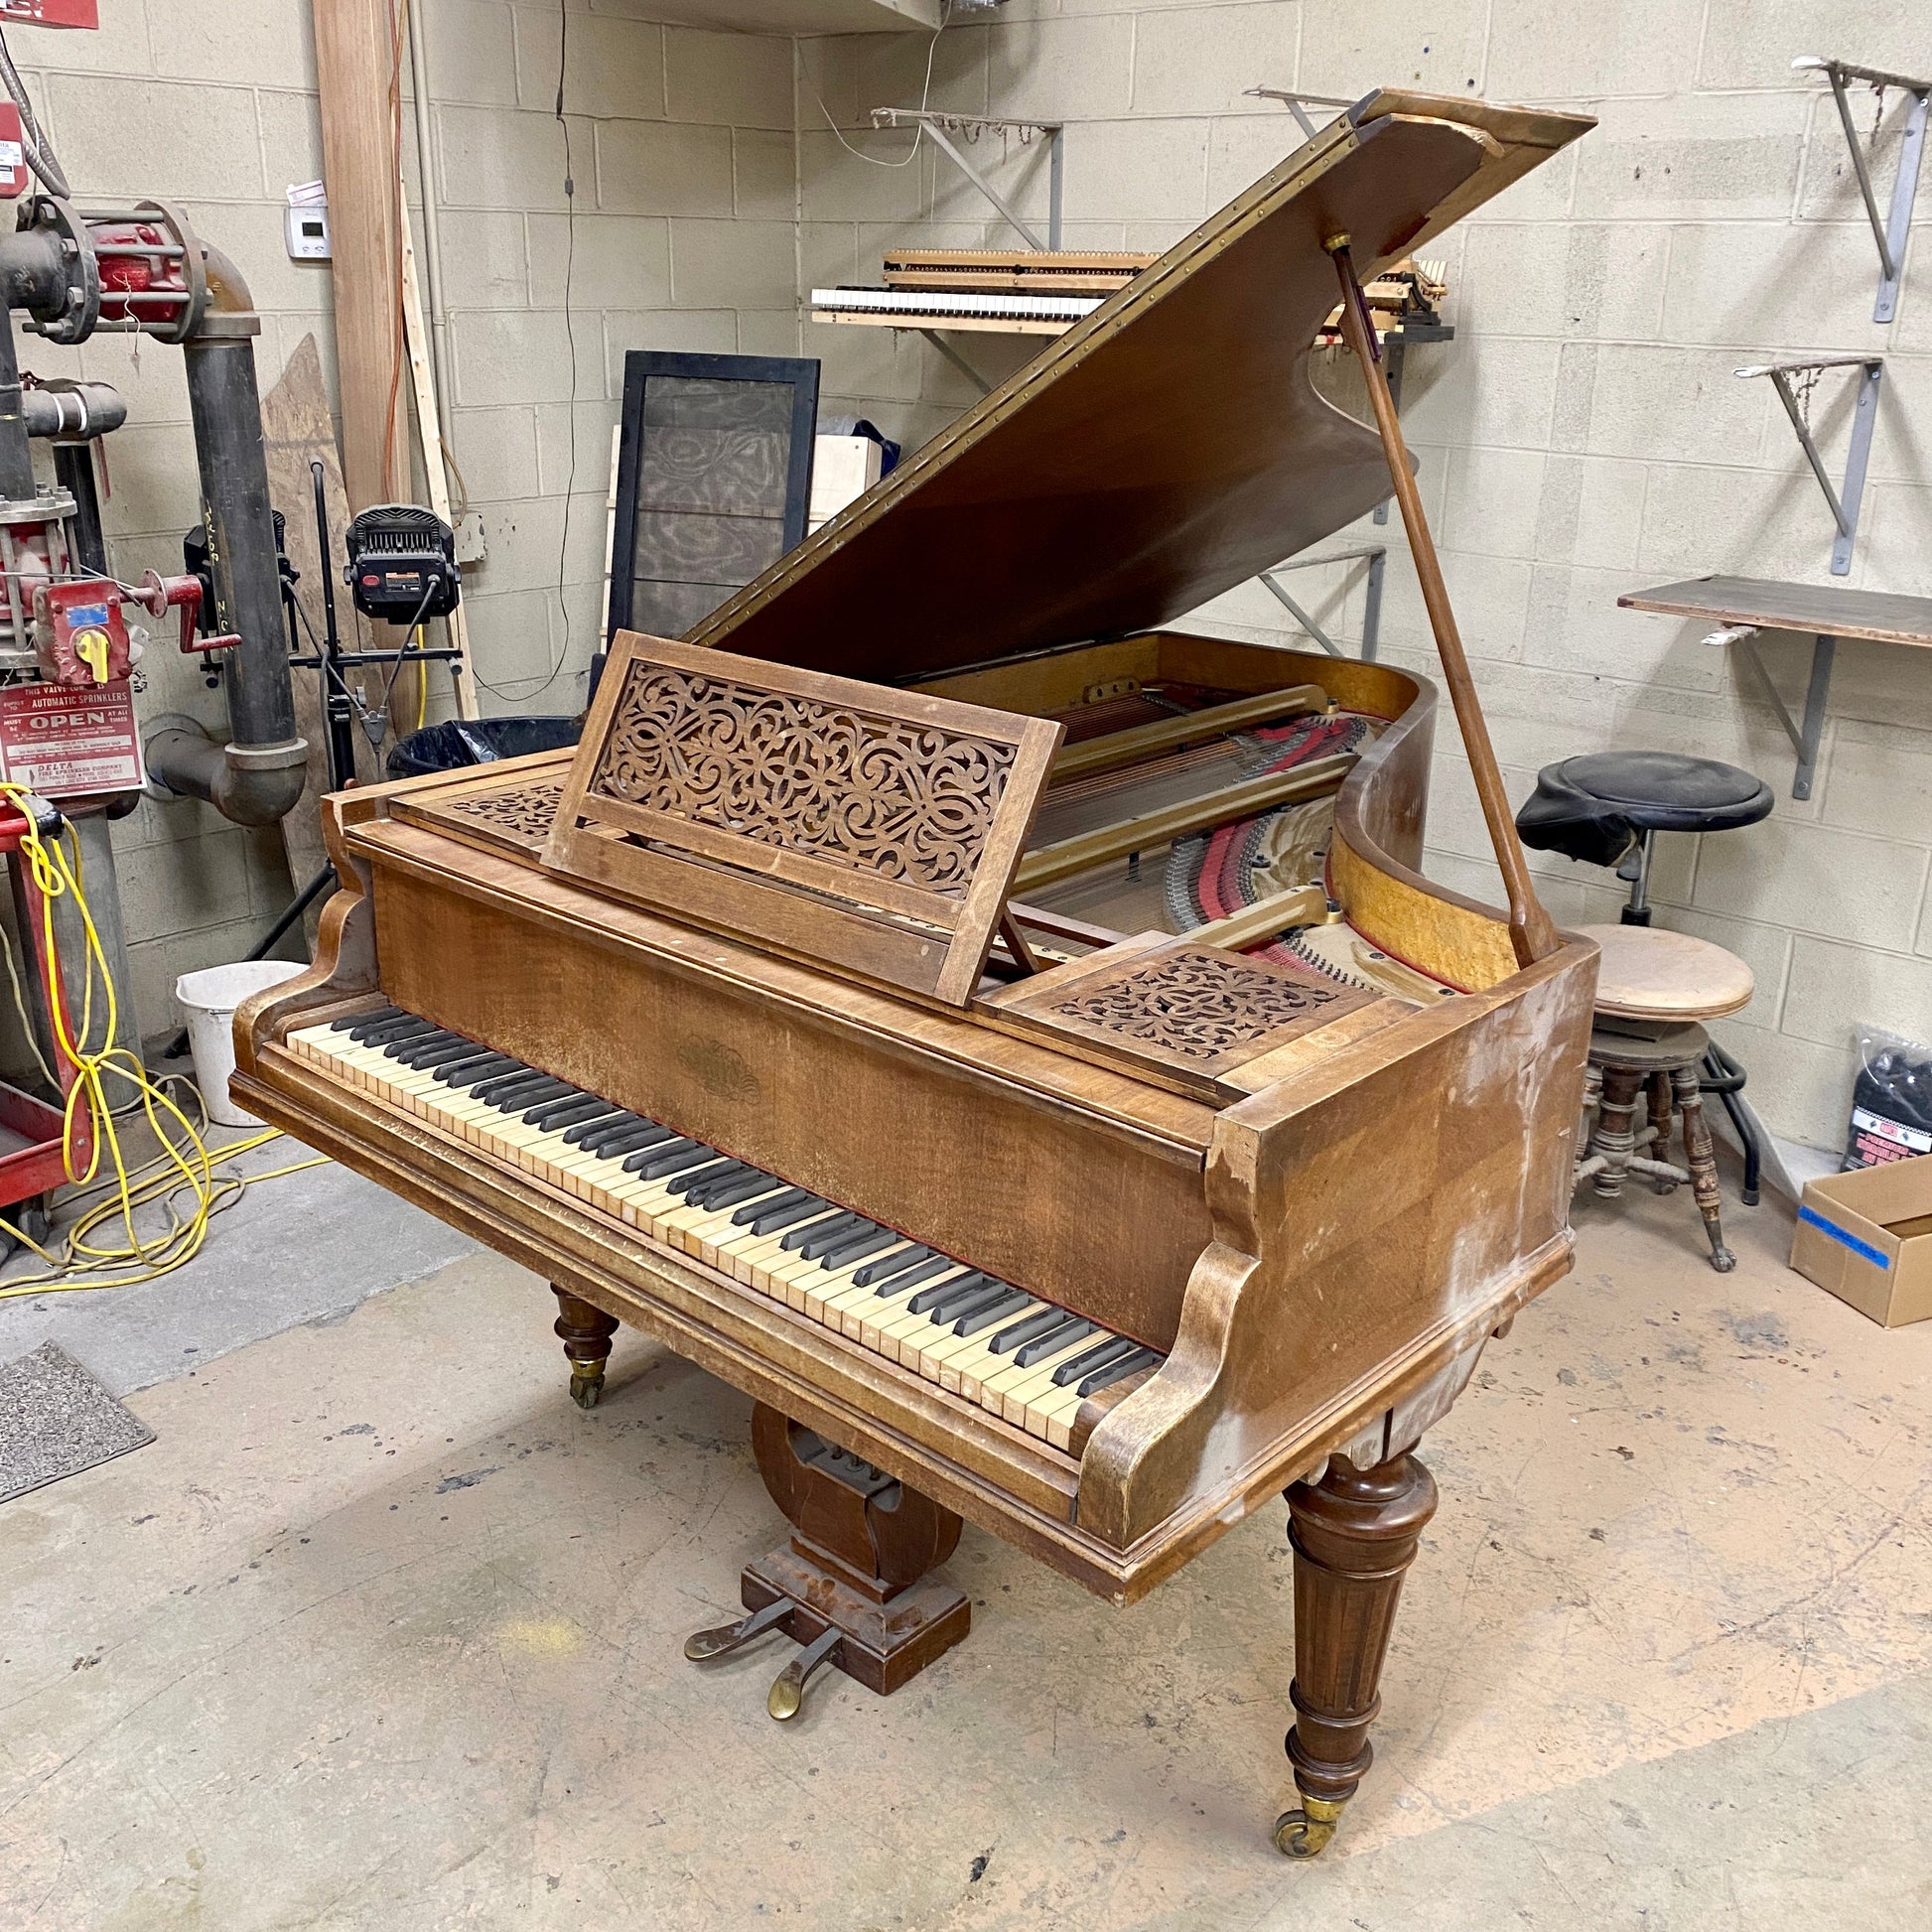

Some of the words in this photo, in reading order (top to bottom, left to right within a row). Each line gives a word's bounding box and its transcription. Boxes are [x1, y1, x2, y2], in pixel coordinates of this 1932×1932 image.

[32, 696, 76, 708] AUTOMATIC
[78, 692, 127, 705] SPRINKLERS
[29, 712, 105, 730] OPEN
[38, 761, 73, 772] DELTA
